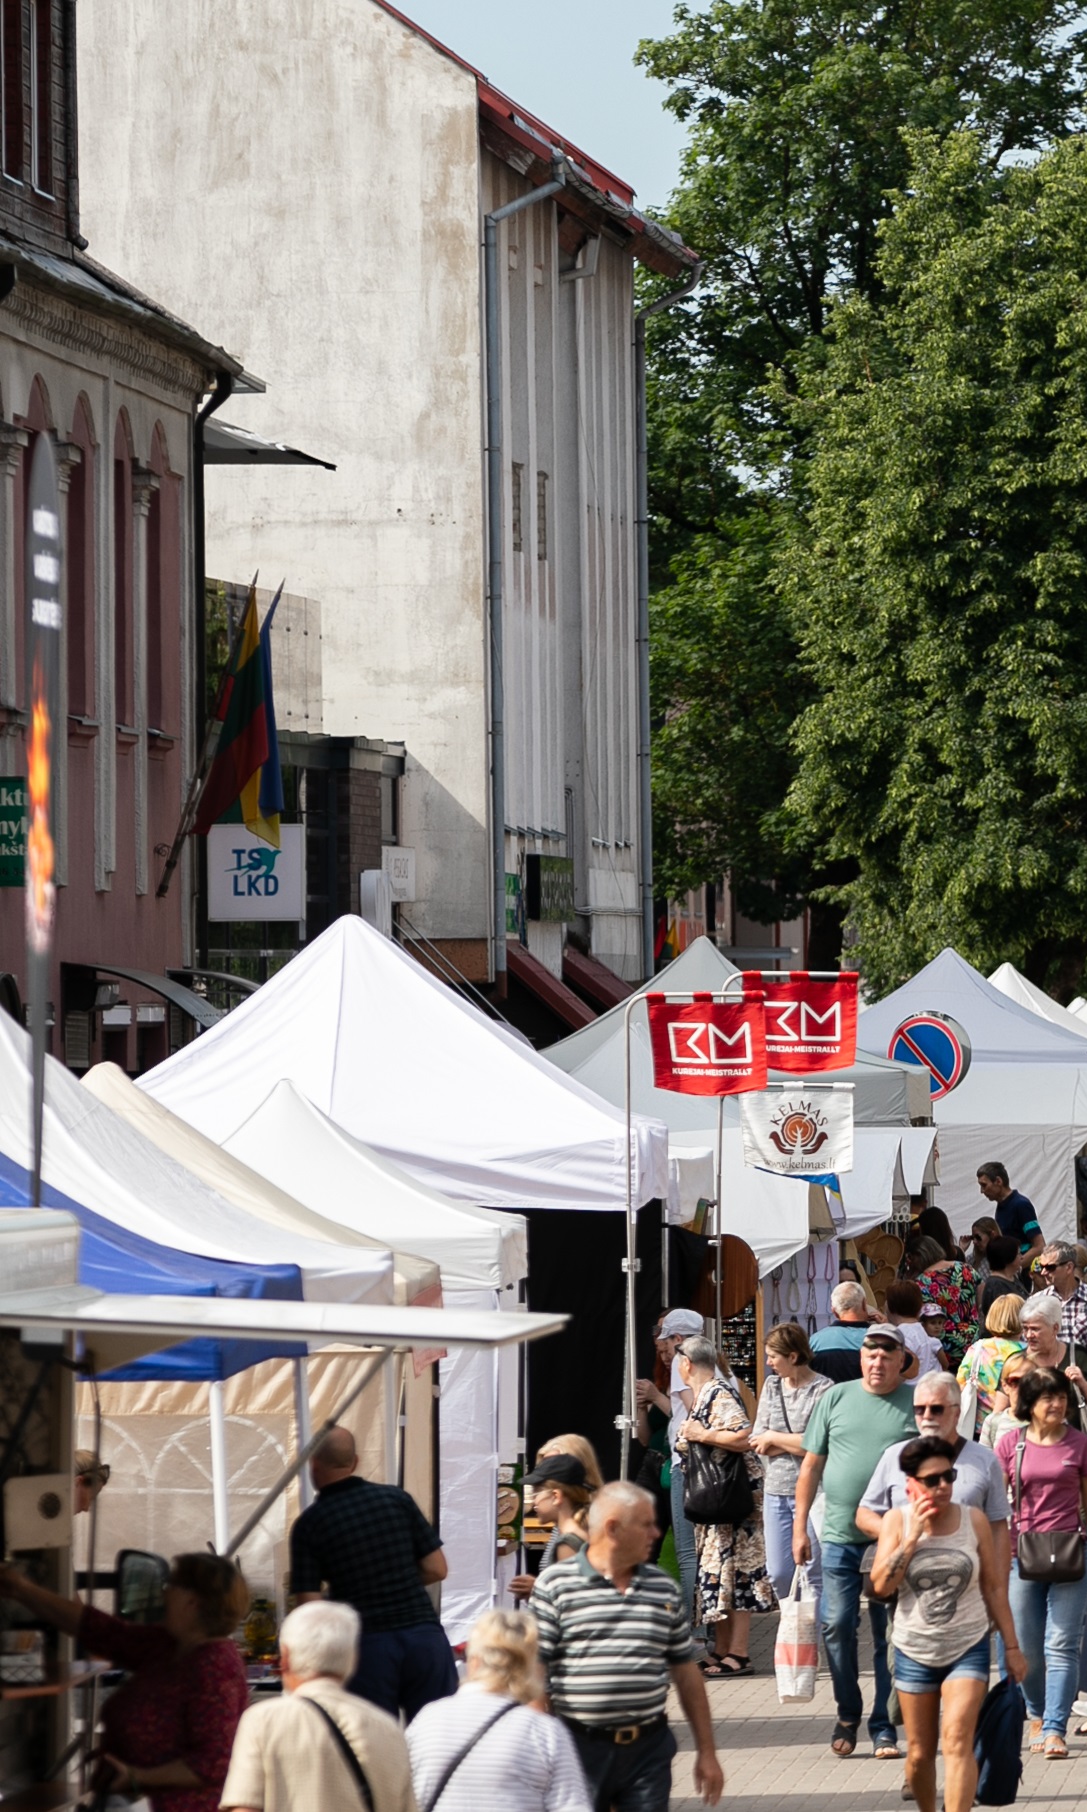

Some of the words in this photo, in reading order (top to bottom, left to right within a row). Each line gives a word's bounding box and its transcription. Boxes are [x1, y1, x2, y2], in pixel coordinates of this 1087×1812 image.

[232, 848, 263, 871] TS
[233, 875, 279, 896] LKD
[668, 1022, 753, 1064] KM
[770, 1100, 829, 1127] KELMAS
[763, 1156, 837, 1170] www.kelmas.lt
